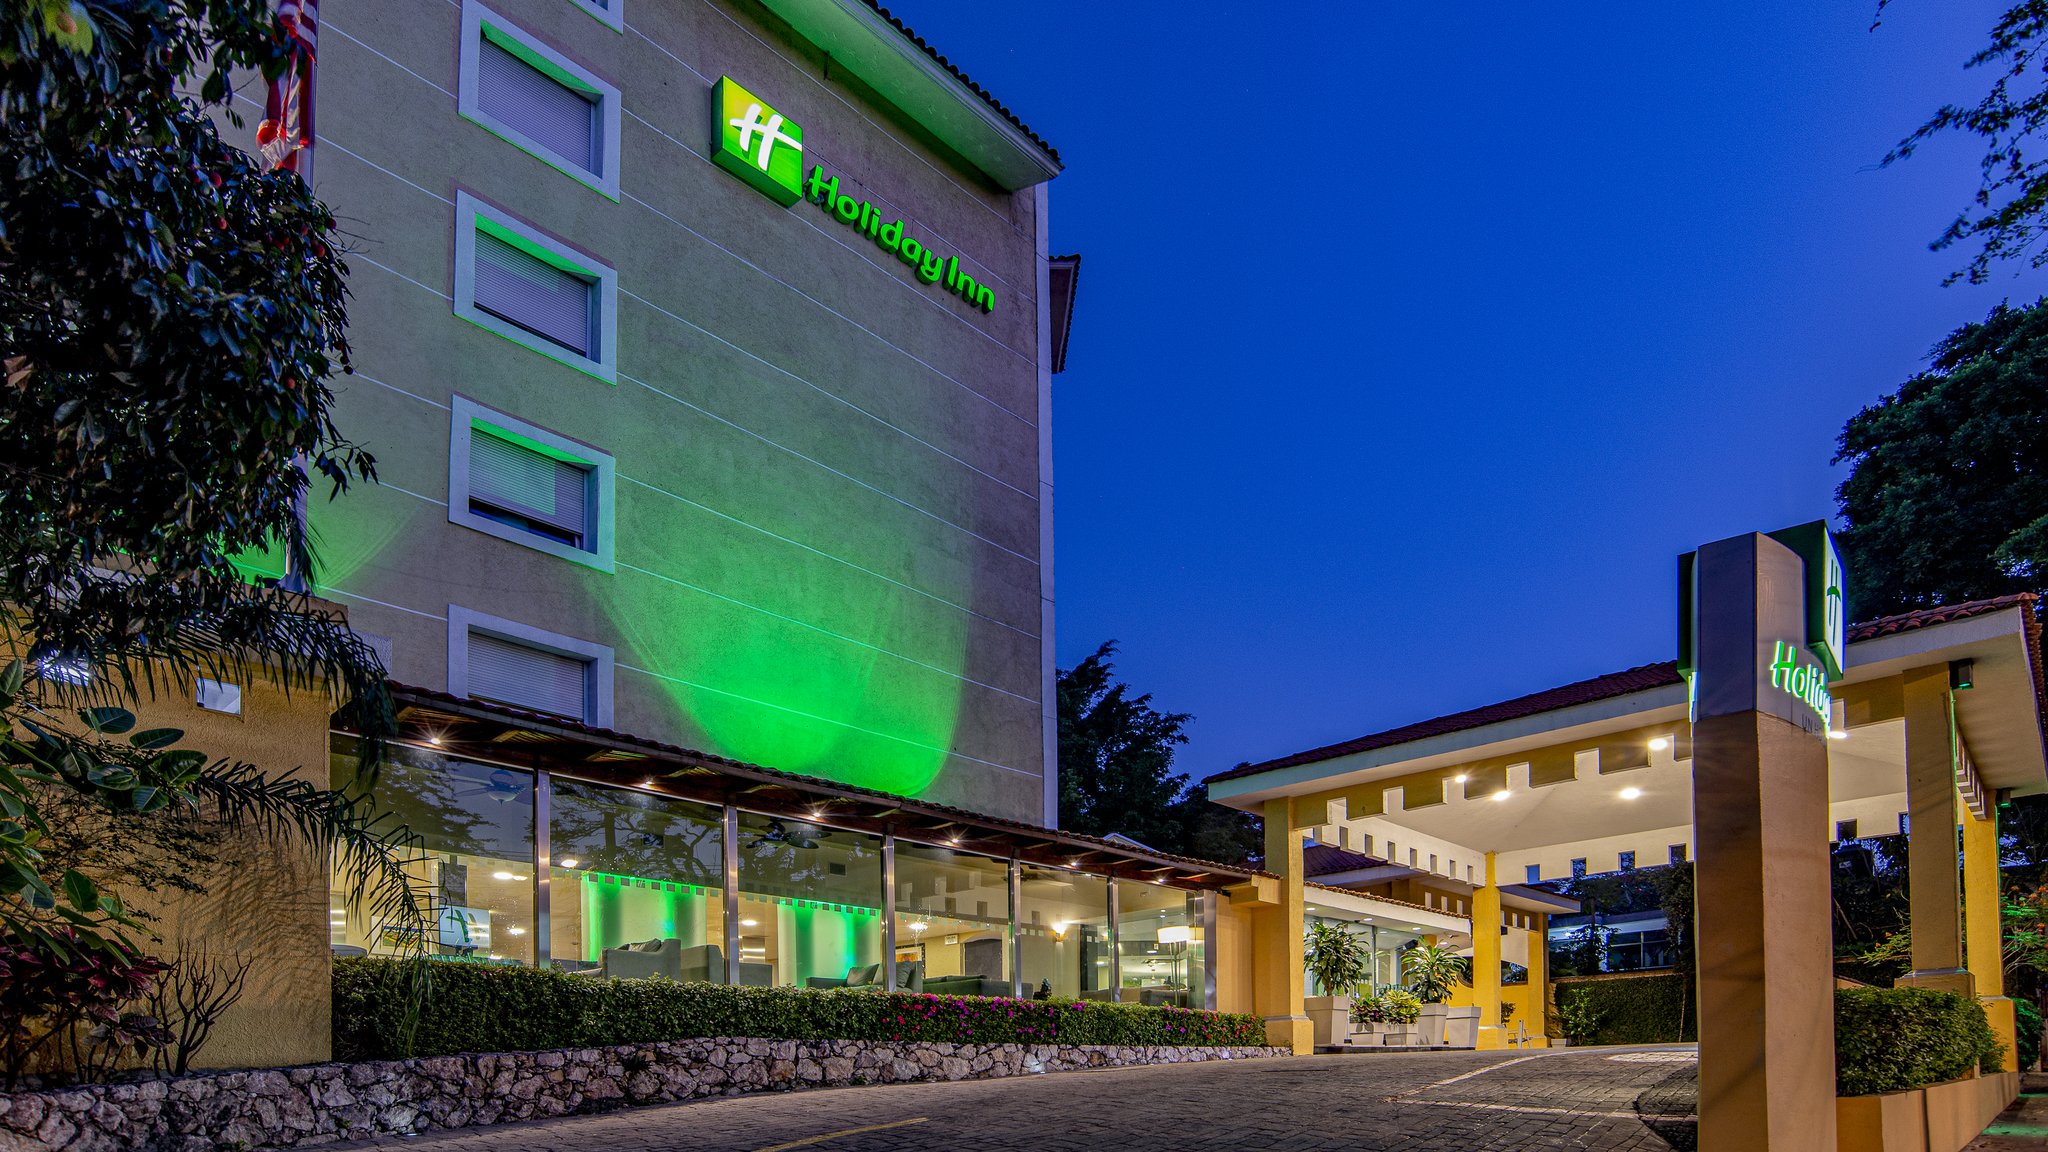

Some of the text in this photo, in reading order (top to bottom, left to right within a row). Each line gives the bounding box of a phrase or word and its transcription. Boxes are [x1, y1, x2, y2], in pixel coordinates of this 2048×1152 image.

[805, 164, 996, 314] Holiday Inn
[1769, 641, 1831, 739] Holid
